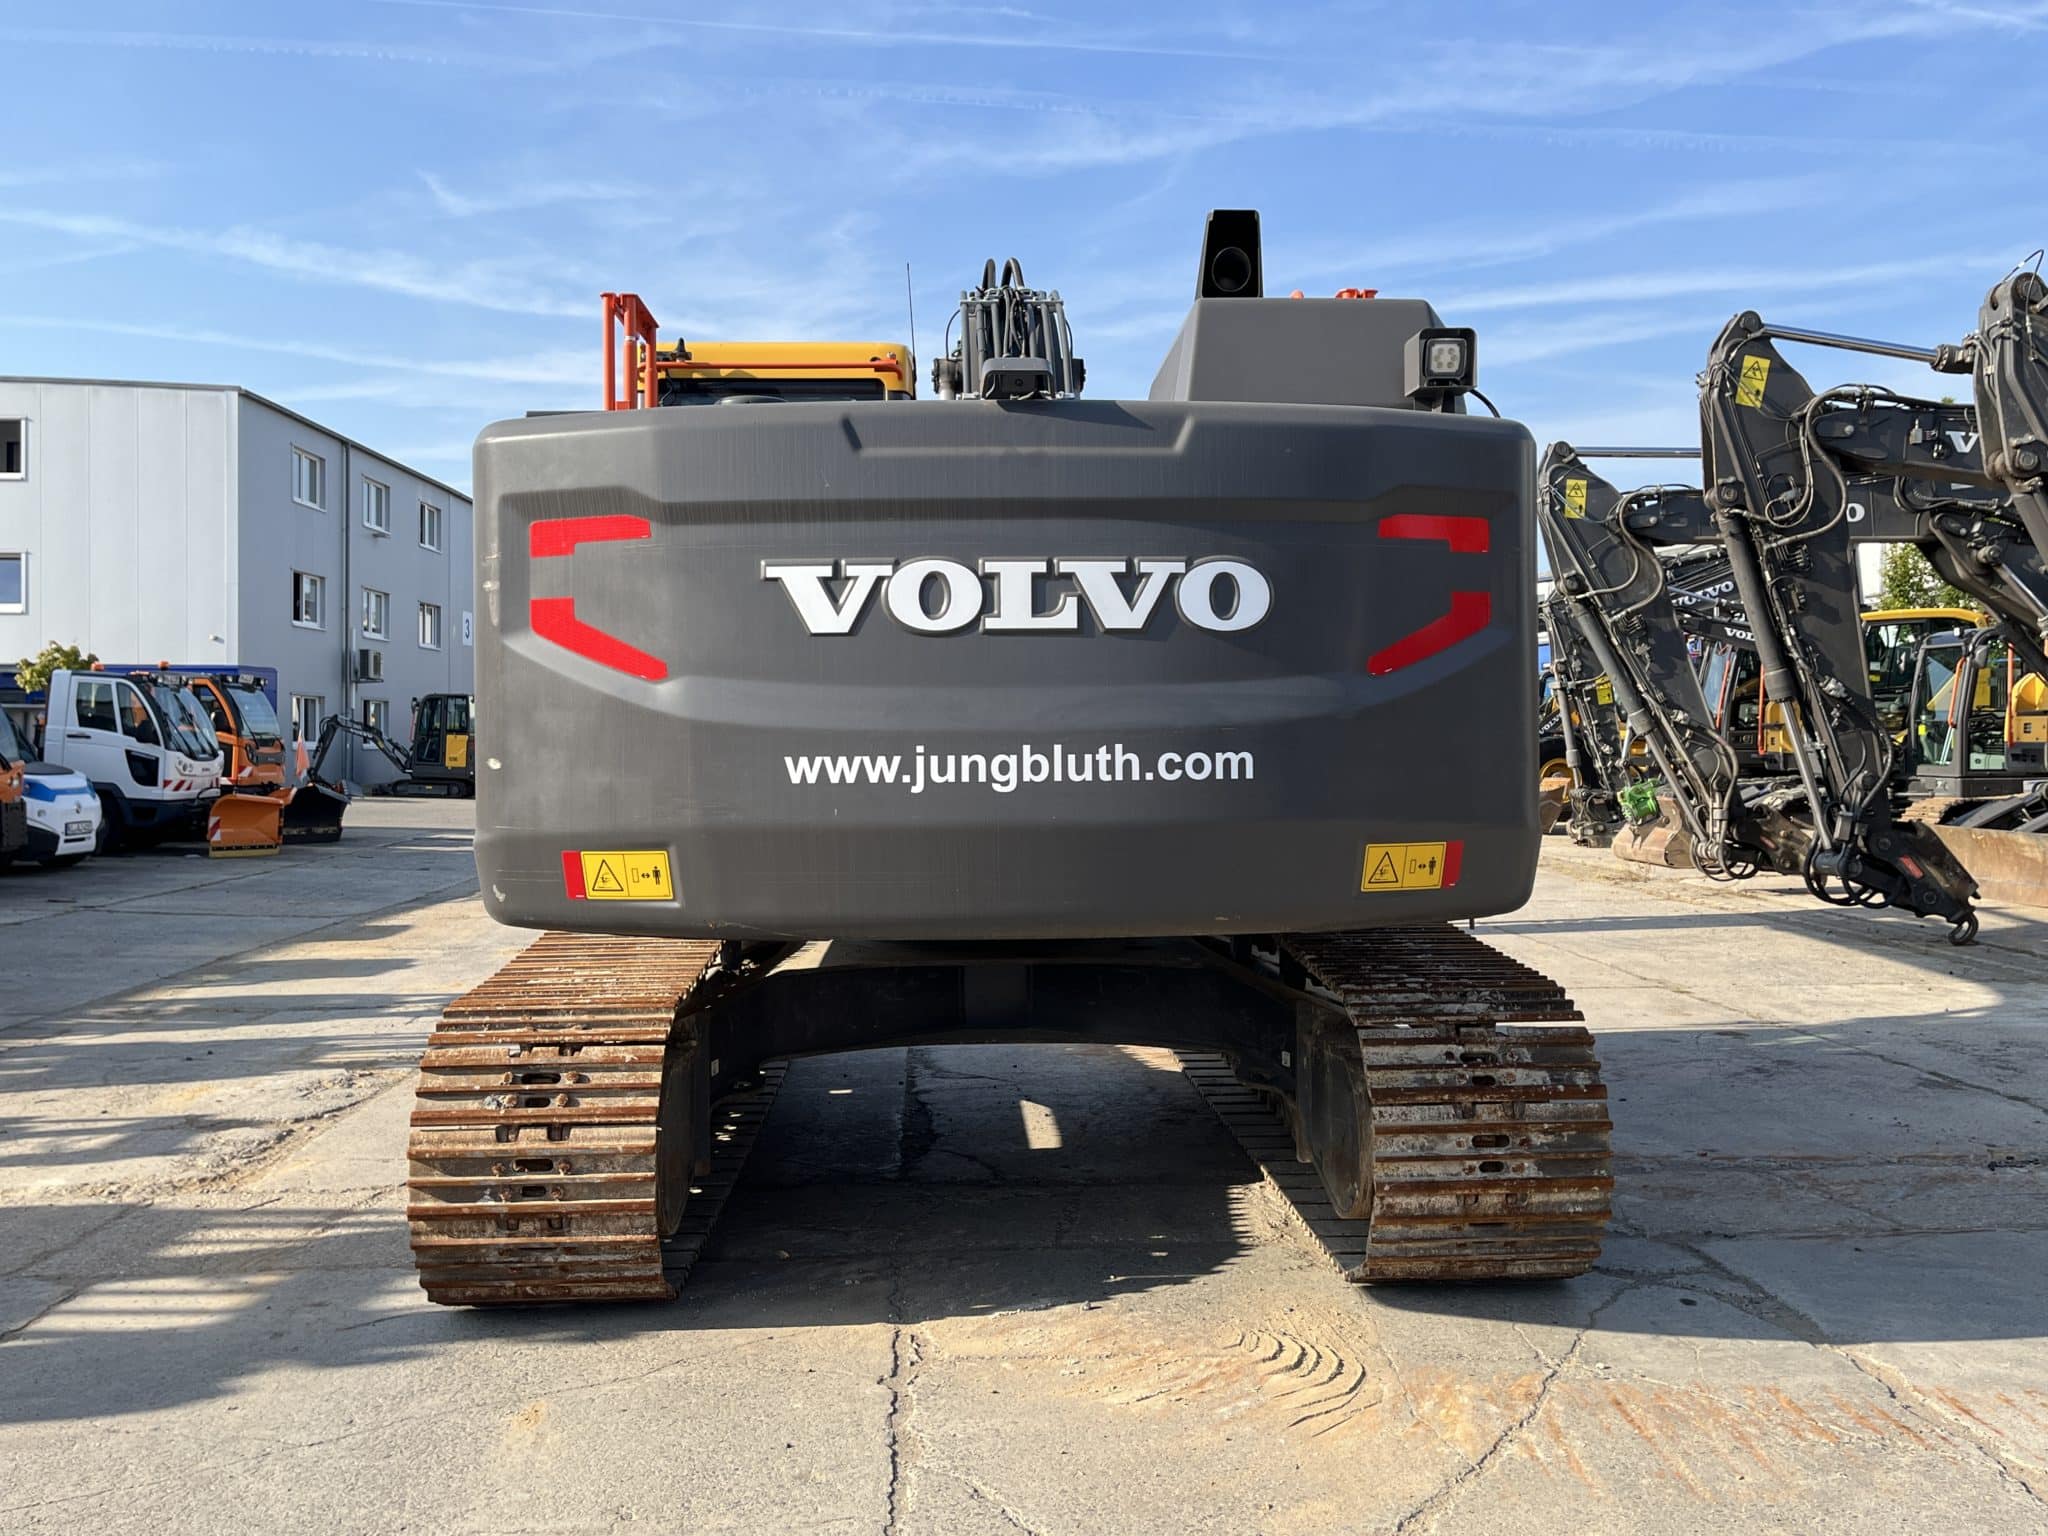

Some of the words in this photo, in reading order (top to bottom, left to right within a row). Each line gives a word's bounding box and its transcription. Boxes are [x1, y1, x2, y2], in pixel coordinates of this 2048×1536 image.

[762, 558, 1271, 635] VOLVO
[1671, 581, 1735, 606] VOVO
[465, 618, 470, 639] 3
[1724, 627, 1756, 641] VOL
[1539, 713, 1561, 734] VOLV
[784, 744, 1253, 793] www.jungbluth.com
